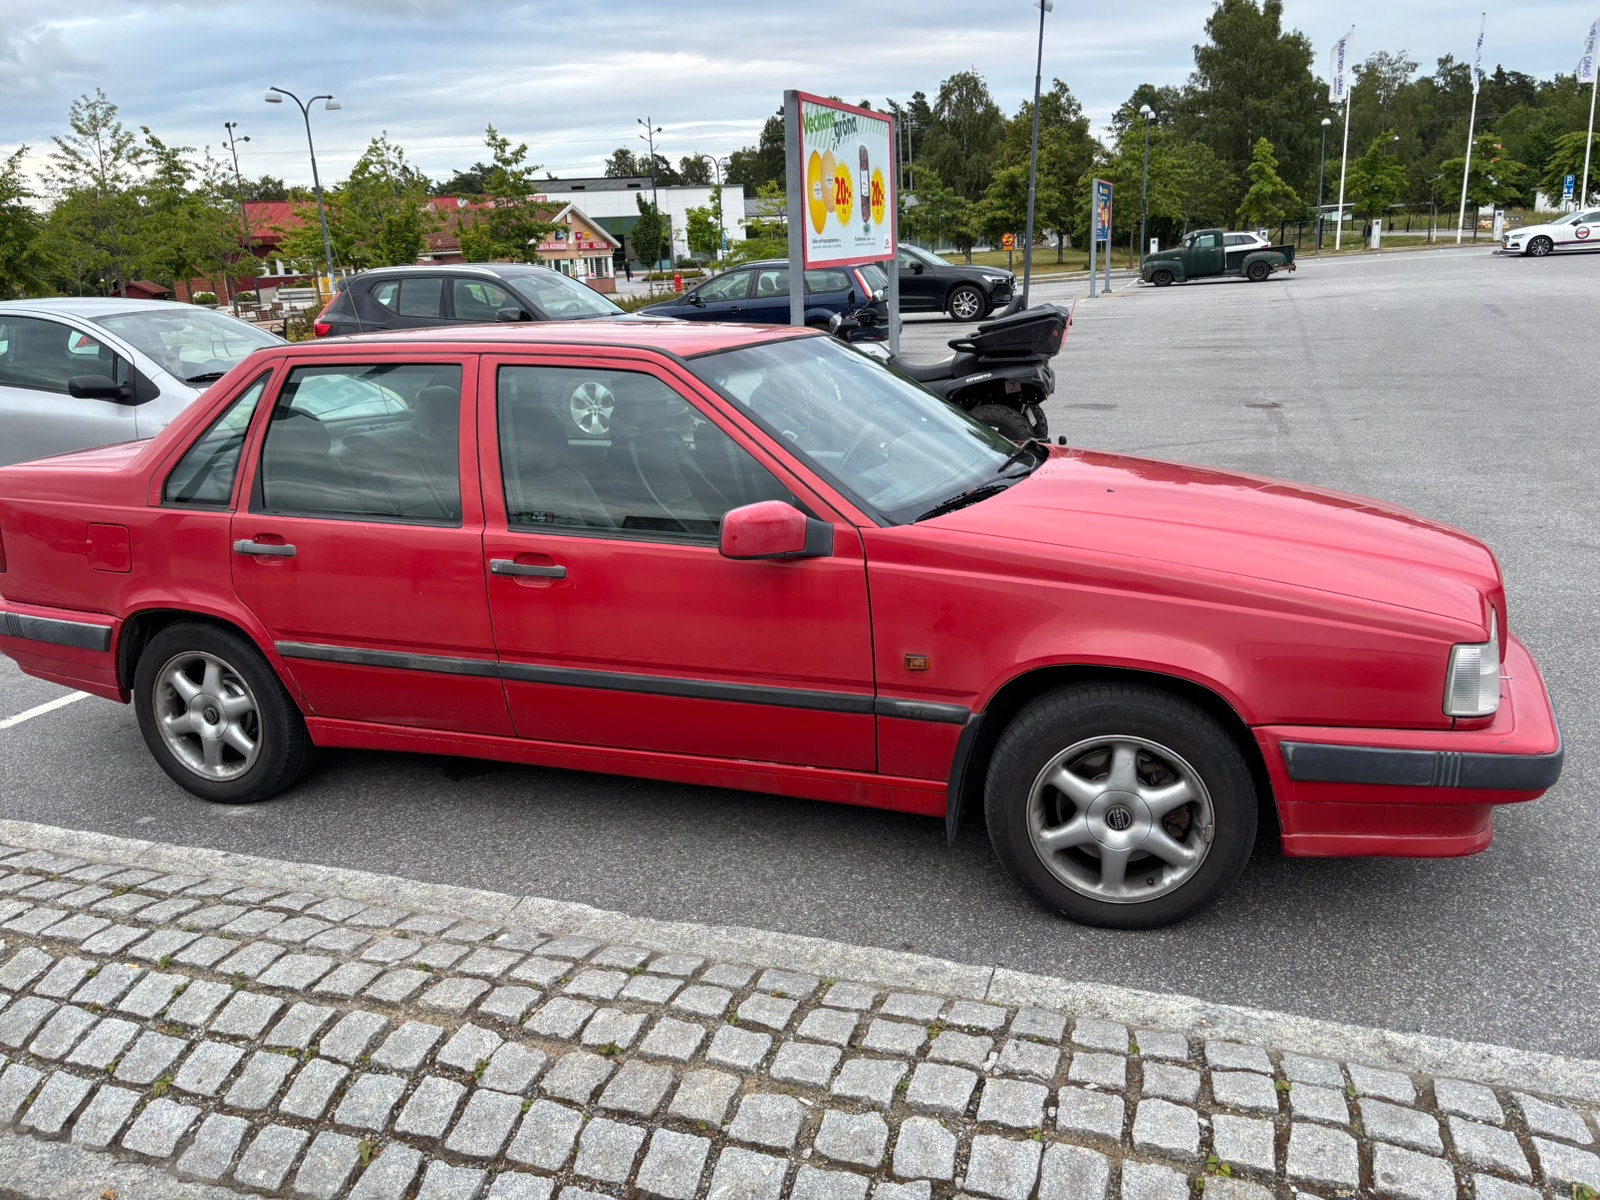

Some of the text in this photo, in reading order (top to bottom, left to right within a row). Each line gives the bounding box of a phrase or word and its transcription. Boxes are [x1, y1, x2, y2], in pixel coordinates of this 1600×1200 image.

[802, 109, 836, 135] Veckans
[834, 113, 857, 144] gröna
[835, 177, 851, 205] 20:-
[872, 181, 884, 207] 20:-
[966, 373, 992, 383] CFMOTO
